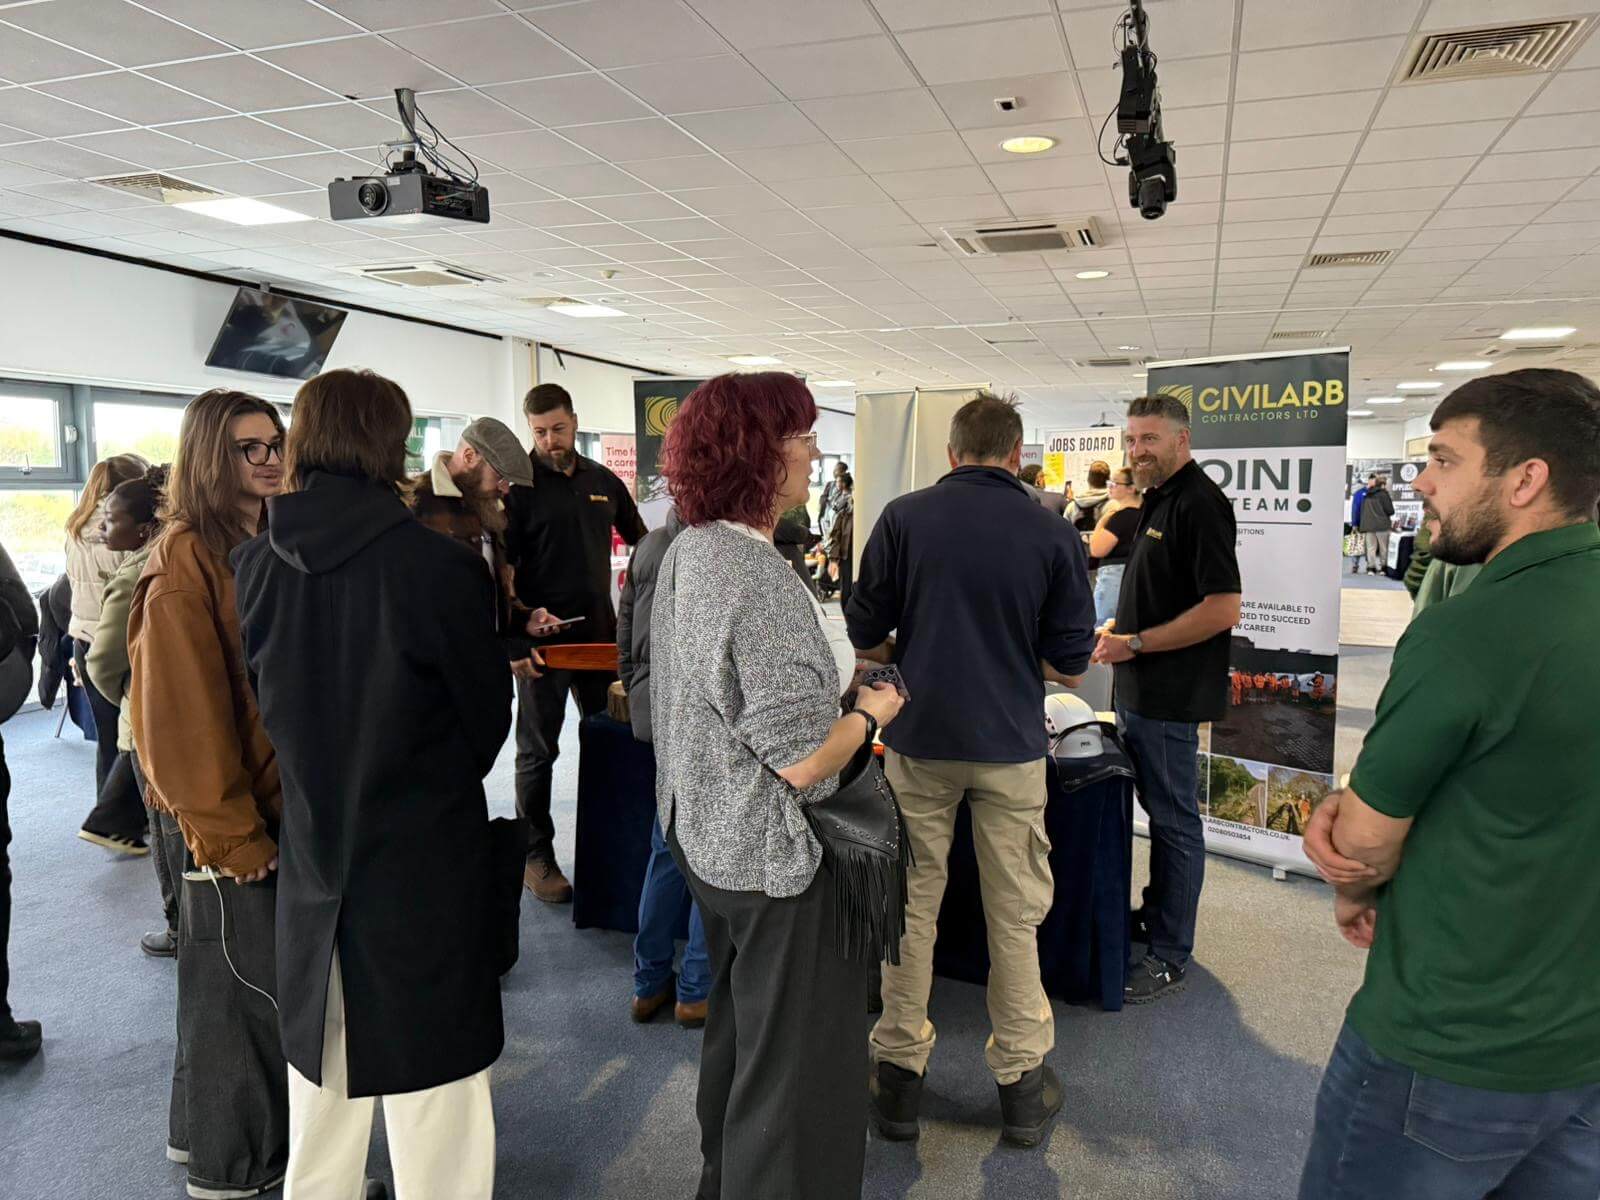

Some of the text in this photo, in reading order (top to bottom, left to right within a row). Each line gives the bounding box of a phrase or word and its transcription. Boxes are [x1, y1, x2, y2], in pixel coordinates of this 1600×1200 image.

[1198, 380, 1344, 412] CIVILARB
[1202, 409, 1318, 423] CONTRACTORS LTD
[1049, 437, 1115, 452] JOBS BOARD
[606, 447, 628, 456] Time
[1258, 602, 1302, 613] AVAILABLE
[1304, 605, 1316, 614] TO
[1240, 612, 1257, 620] DED
[1271, 614, 1311, 625] SUCCEED
[1244, 623, 1276, 633] CAREER
